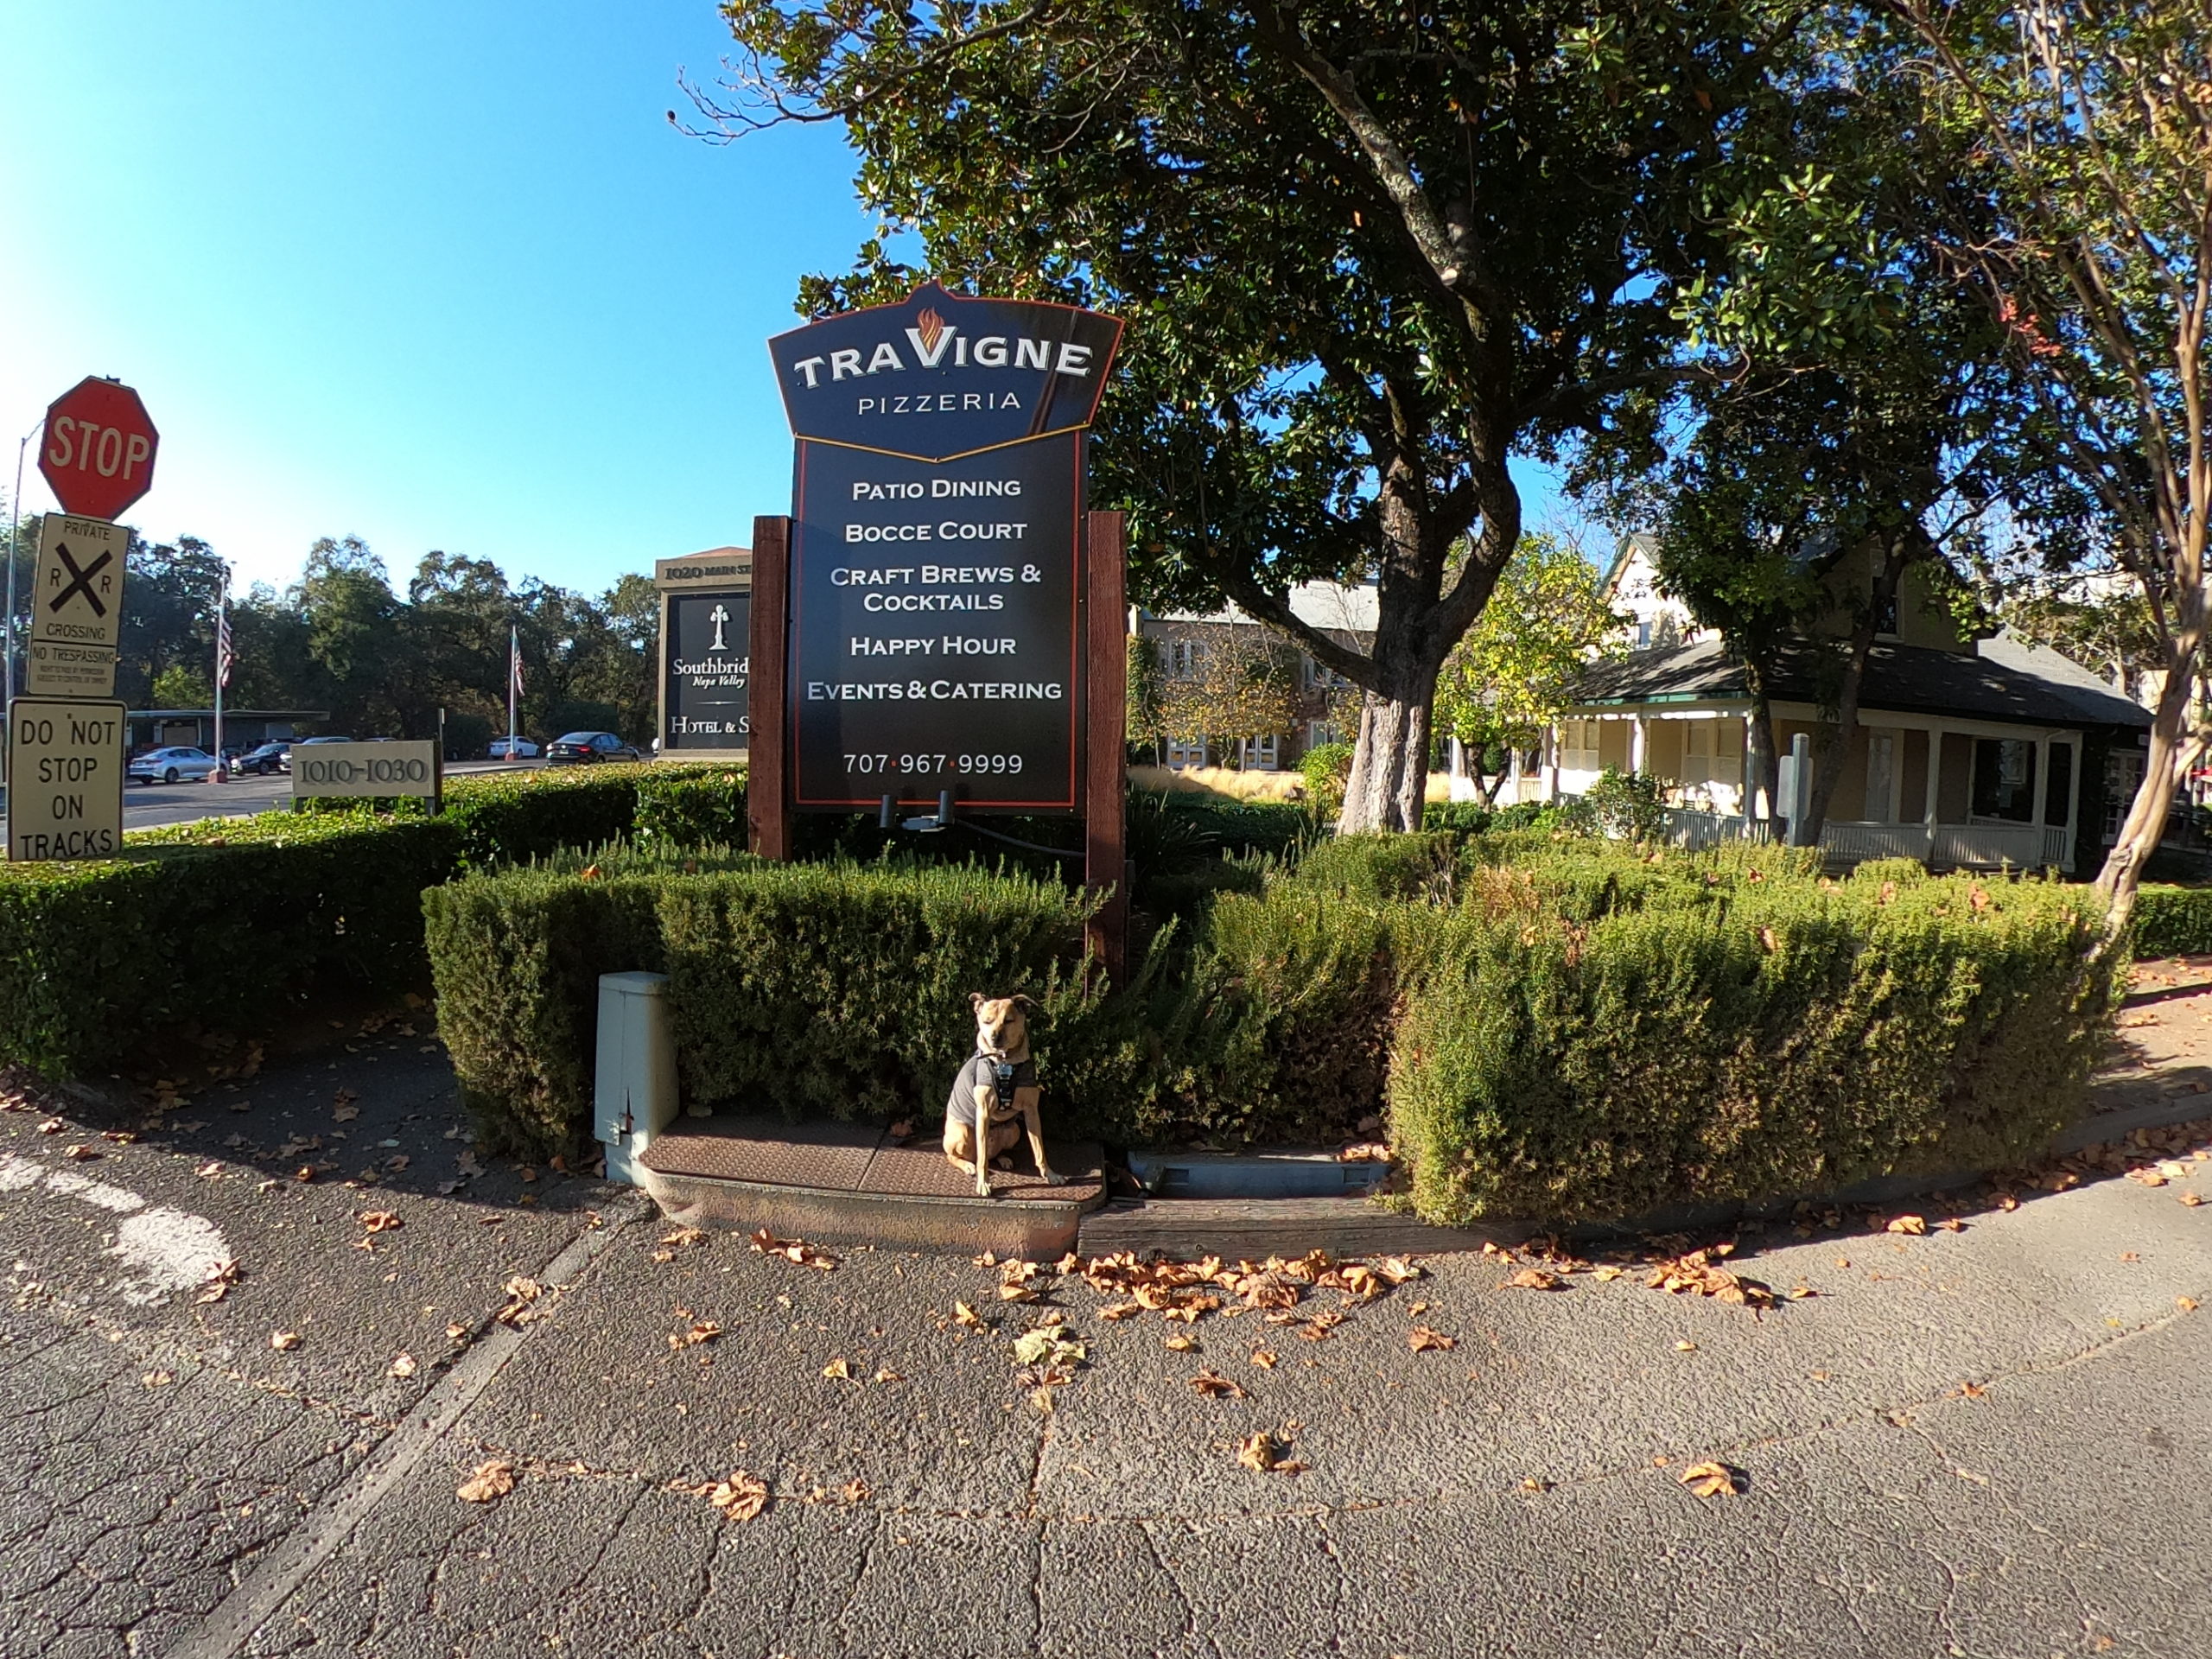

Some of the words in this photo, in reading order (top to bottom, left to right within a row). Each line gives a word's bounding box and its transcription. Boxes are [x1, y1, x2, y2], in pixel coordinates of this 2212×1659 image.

[858, 391, 1021, 415] PIZZERIA
[49, 416, 150, 480] STOP
[853, 481, 925, 501] PATIO
[931, 479, 1021, 499] DINING
[64, 520, 111, 543] PRIVATE
[845, 524, 932, 543] BOCCE
[938, 520, 1028, 540] COURT
[664, 567, 702, 581] 1020
[830, 568, 914, 587] CRAFT
[921, 564, 1014, 584] BREWS
[1020, 563, 1041, 583] &
[863, 592, 1004, 612] COCKTAILS
[46, 622, 105, 642] CROSSING
[33, 646, 47, 660] NO
[52, 647, 114, 664] TRESPASSING
[850, 636, 936, 656] HAPPY
[942, 635, 1016, 655] HOUR
[672, 657, 750, 675] Southbrid
[692, 676, 717, 690] Napa
[719, 674, 746, 690] Valley
[21, 720, 54, 746] DO
[71, 721, 116, 746] NOT
[671, 715, 722, 734] HOTEL
[725, 721, 736, 734] &
[38, 757, 98, 784] STOP
[300, 759, 425, 783] 1010-1030
[52, 795, 83, 820] ON
[21, 830, 112, 861] TRACKS
